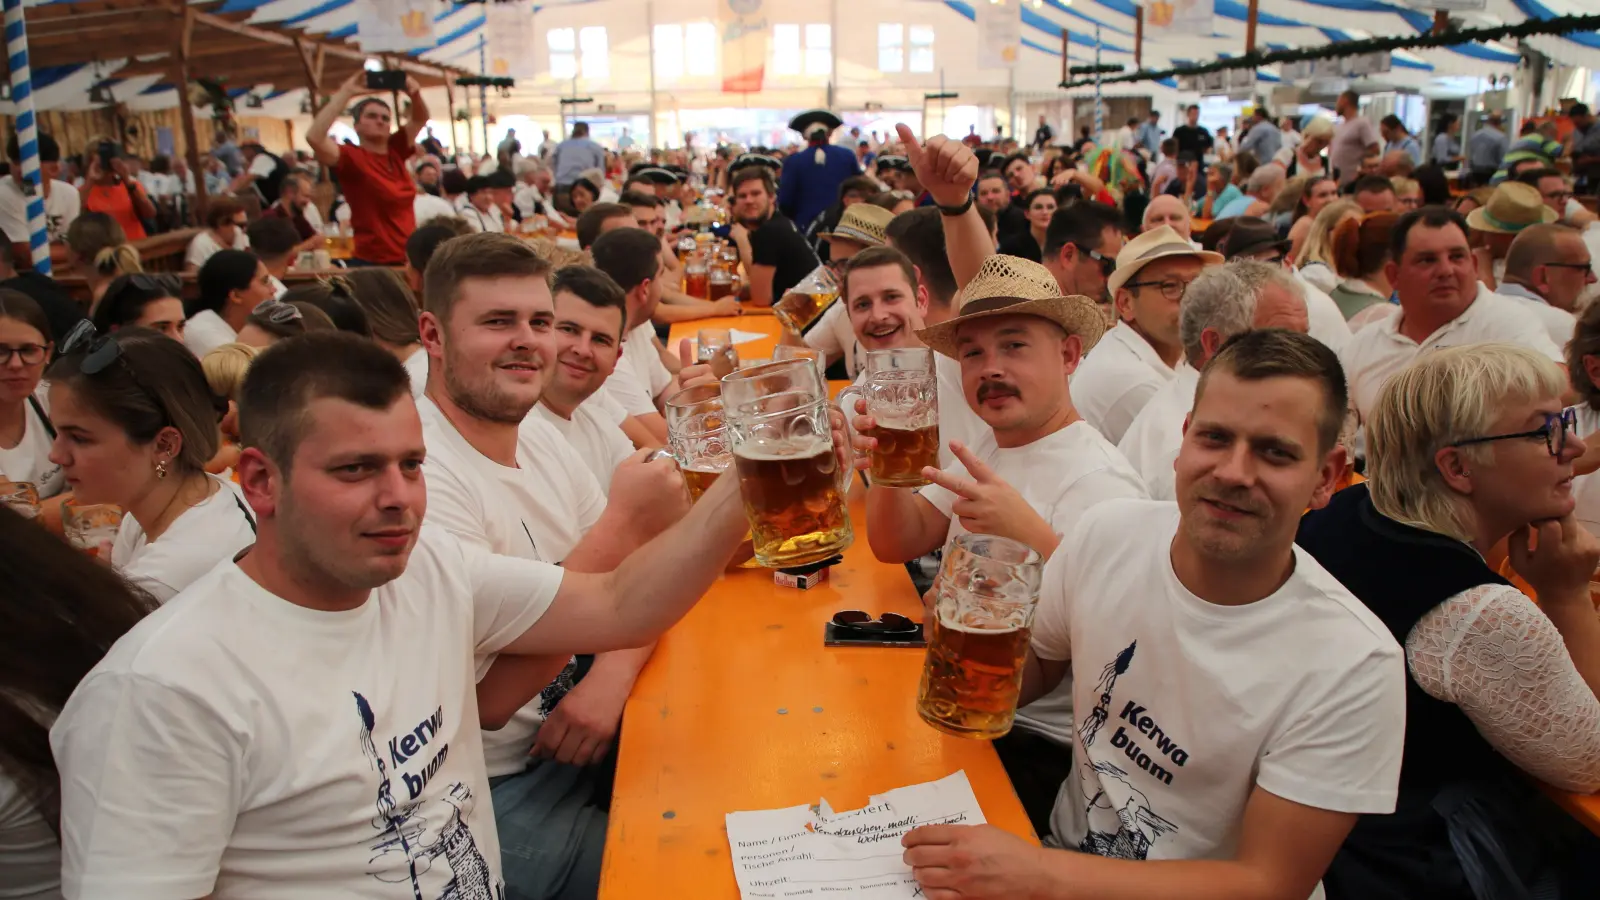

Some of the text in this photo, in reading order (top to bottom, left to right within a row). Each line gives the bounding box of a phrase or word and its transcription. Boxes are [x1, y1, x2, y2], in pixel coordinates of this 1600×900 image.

[388, 705, 443, 769] Kerwa
[1110, 727, 1174, 785] buam
[1119, 700, 1189, 767] Kerwa
[402, 743, 449, 801] buam
[738, 840, 768, 848] Name
[741, 849, 788, 860] Personen
[743, 861, 775, 870] Tische
